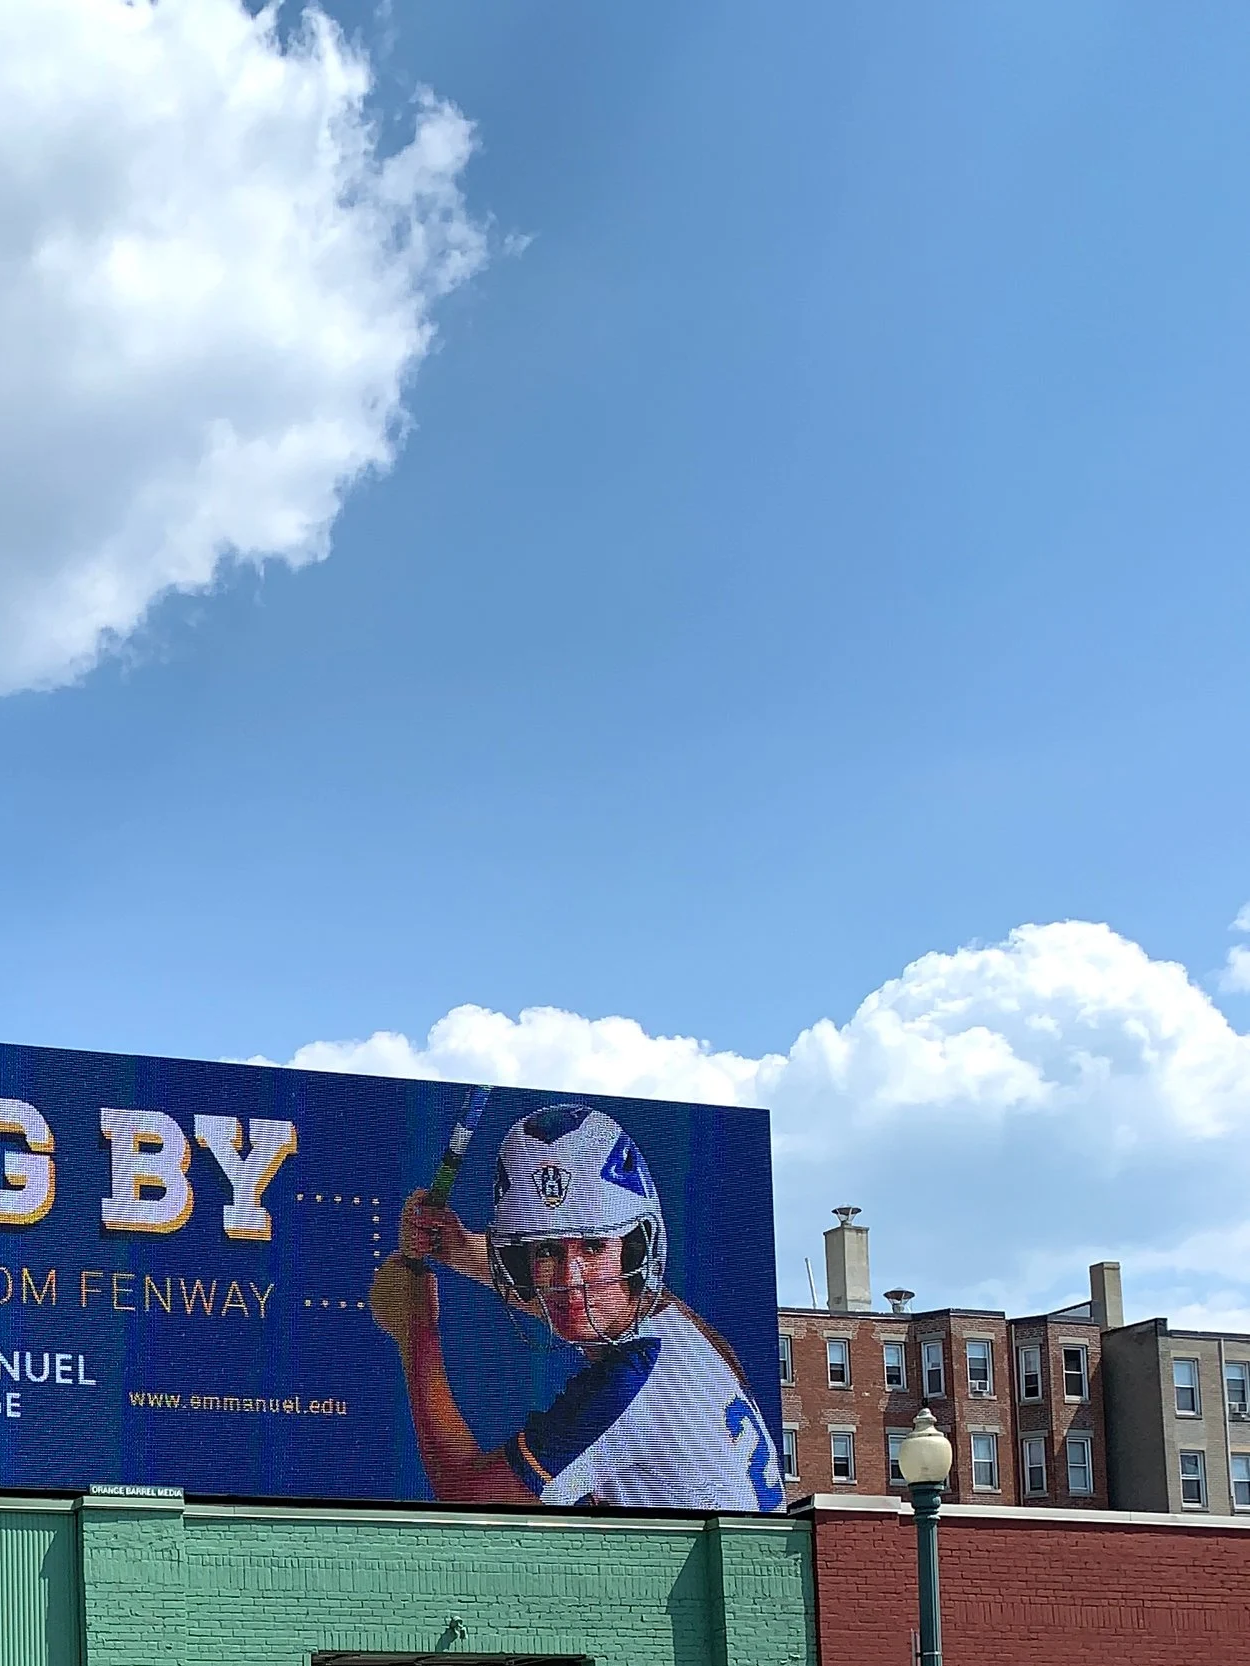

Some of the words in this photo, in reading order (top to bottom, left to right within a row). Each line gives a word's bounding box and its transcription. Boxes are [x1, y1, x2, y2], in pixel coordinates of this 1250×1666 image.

[99, 1106, 298, 1242] BY
[80, 1271, 276, 1319] FENWAY
[128, 1391, 347, 1416] www.emmanuel.edu
[91, 1485, 125, 1495] ORANGE
[125, 1487, 157, 1496] BARREL
[157, 1489, 183, 1497] MEDIA
